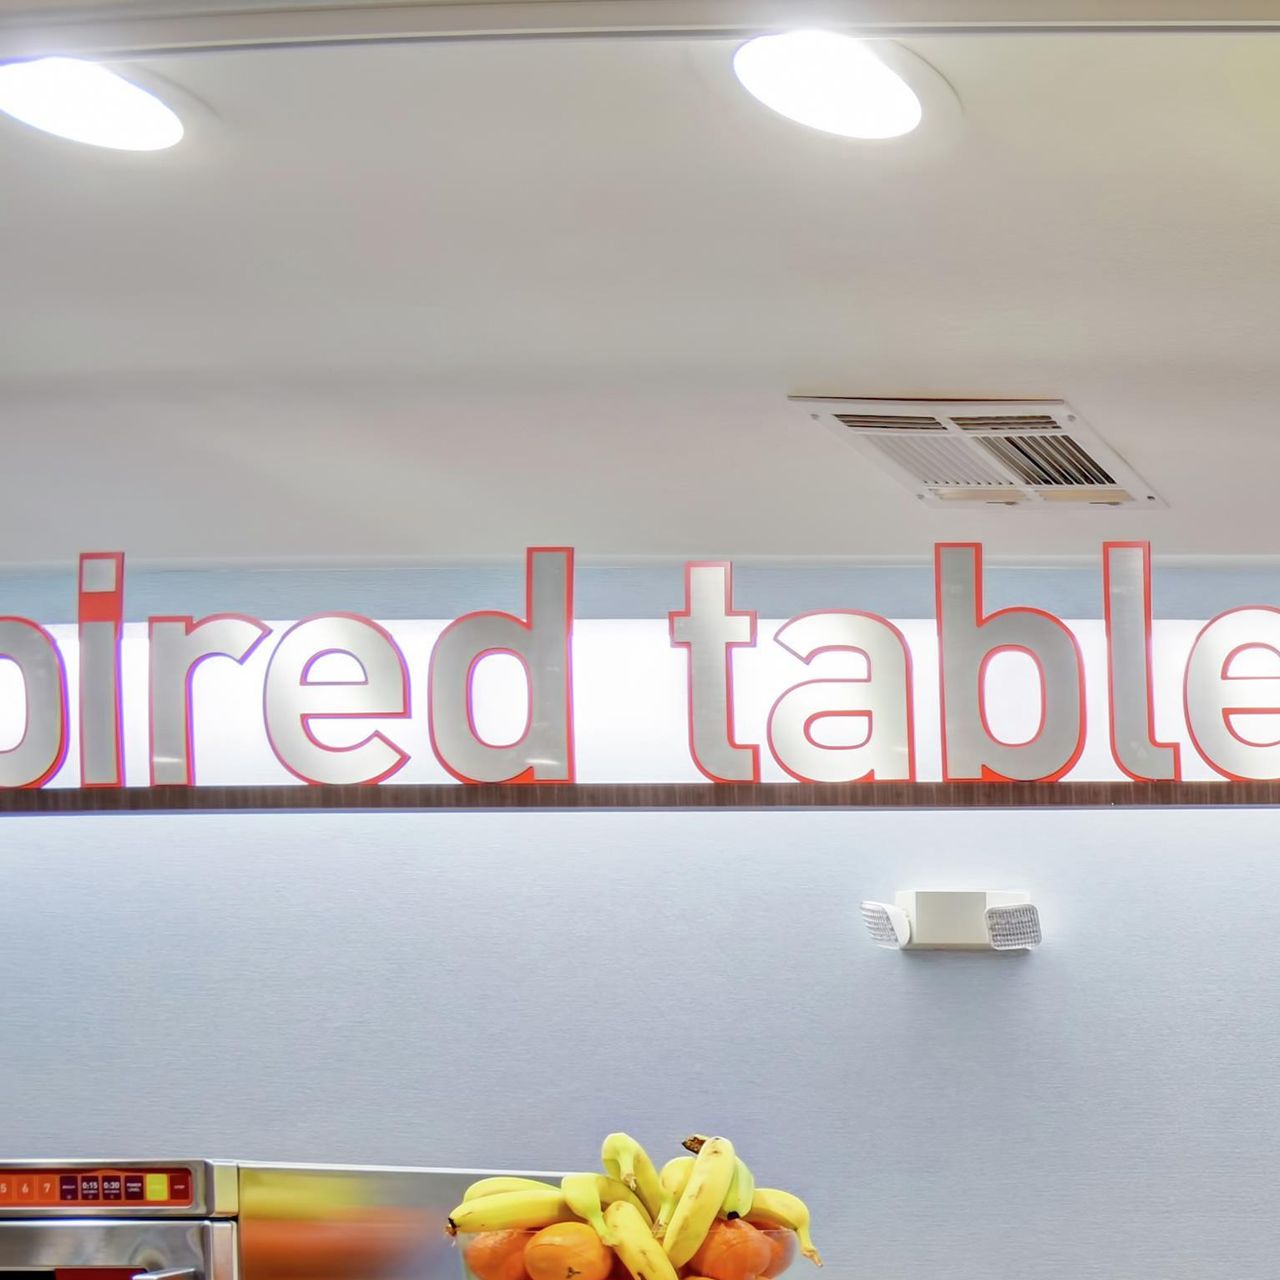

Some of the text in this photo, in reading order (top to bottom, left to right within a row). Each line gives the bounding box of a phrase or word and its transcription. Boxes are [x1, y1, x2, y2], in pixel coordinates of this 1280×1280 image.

[22, 1183, 29, 1194] 6
[43, 1183, 51, 1194] 7
[82, 1181, 98, 1190] 0:15
[103, 1181, 120, 1190] 0:30
